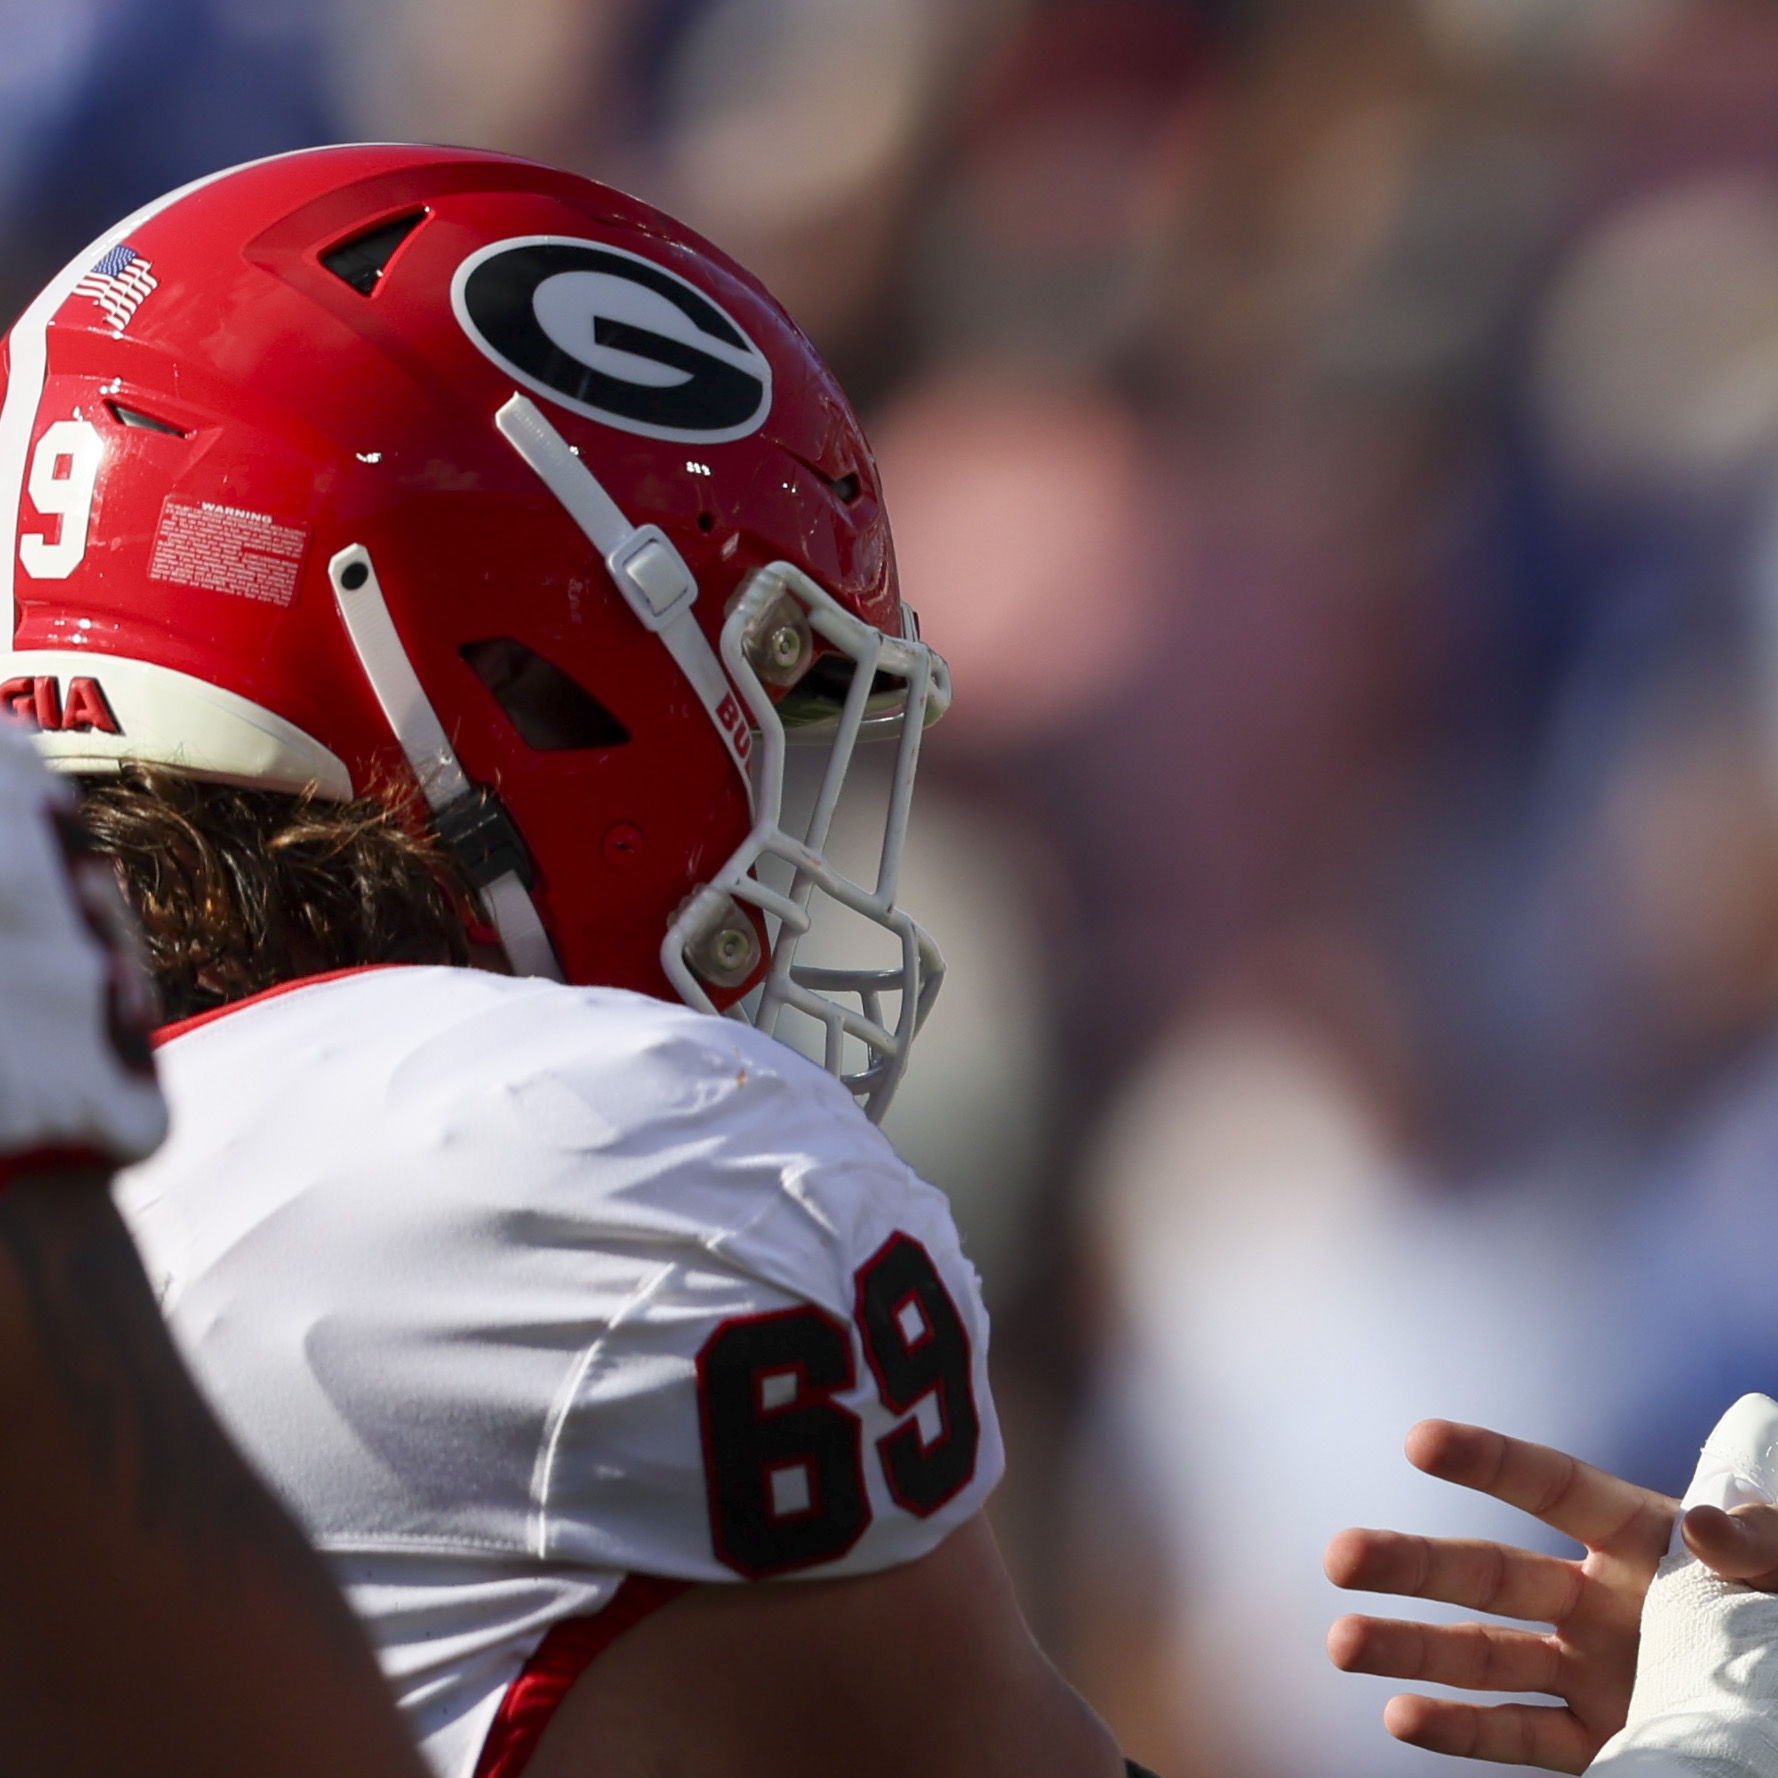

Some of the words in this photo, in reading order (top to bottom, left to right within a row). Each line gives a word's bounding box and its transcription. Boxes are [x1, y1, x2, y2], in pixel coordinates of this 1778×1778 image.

[464, 242, 764, 435] G
[19, 419, 103, 579] 9
[201, 502, 273, 524] WARNING
[694, 1230, 980, 1582] 69
